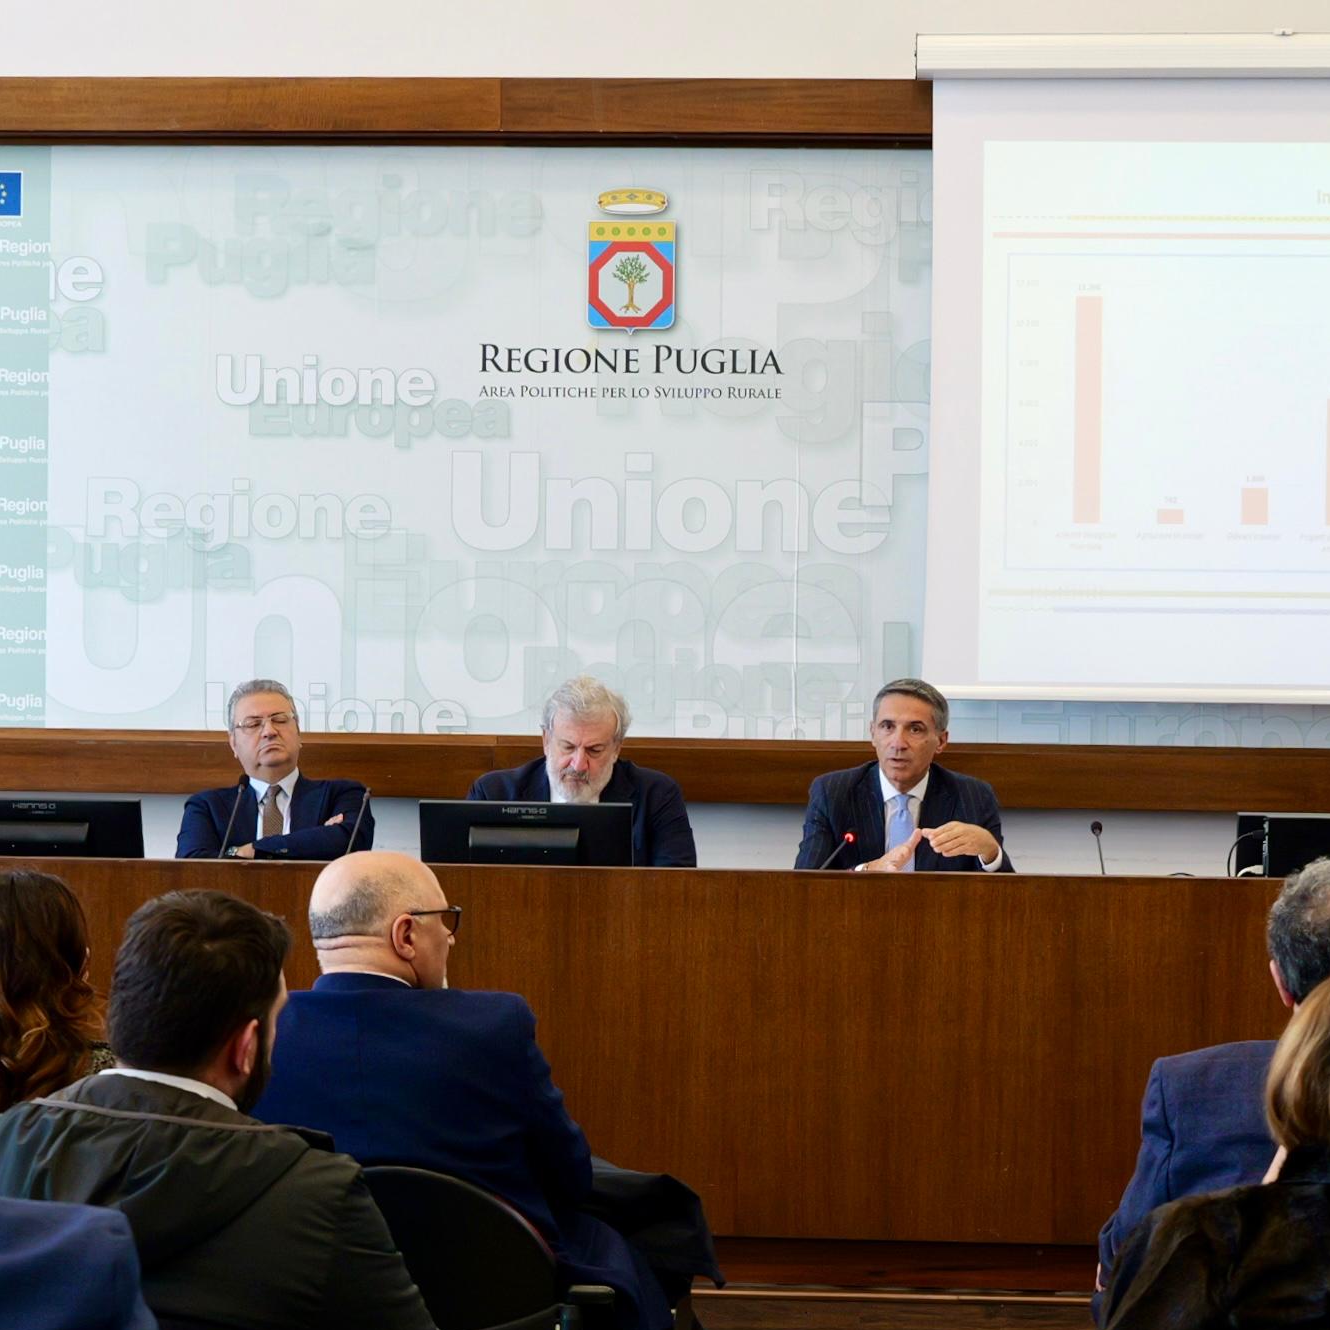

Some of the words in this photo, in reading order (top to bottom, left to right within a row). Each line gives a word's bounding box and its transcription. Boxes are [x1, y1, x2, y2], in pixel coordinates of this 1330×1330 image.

[749, 169, 931, 246] Regi
[0, 305, 47, 324] Puglia
[216, 353, 436, 407] Unione
[478, 343, 640, 374] REGIONE
[652, 344, 785, 376] PUGLIA
[478, 385, 516, 399] AREA
[520, 385, 598, 399] POLITICHE
[602, 386, 628, 399] PER
[631, 386, 650, 399] LO
[654, 386, 723, 400] SVILUPPO
[727, 386, 782, 400] RURALE
[249, 398, 512, 449] Europea
[86, 476, 393, 552] Regione
[450, 450, 893, 555] Unione
